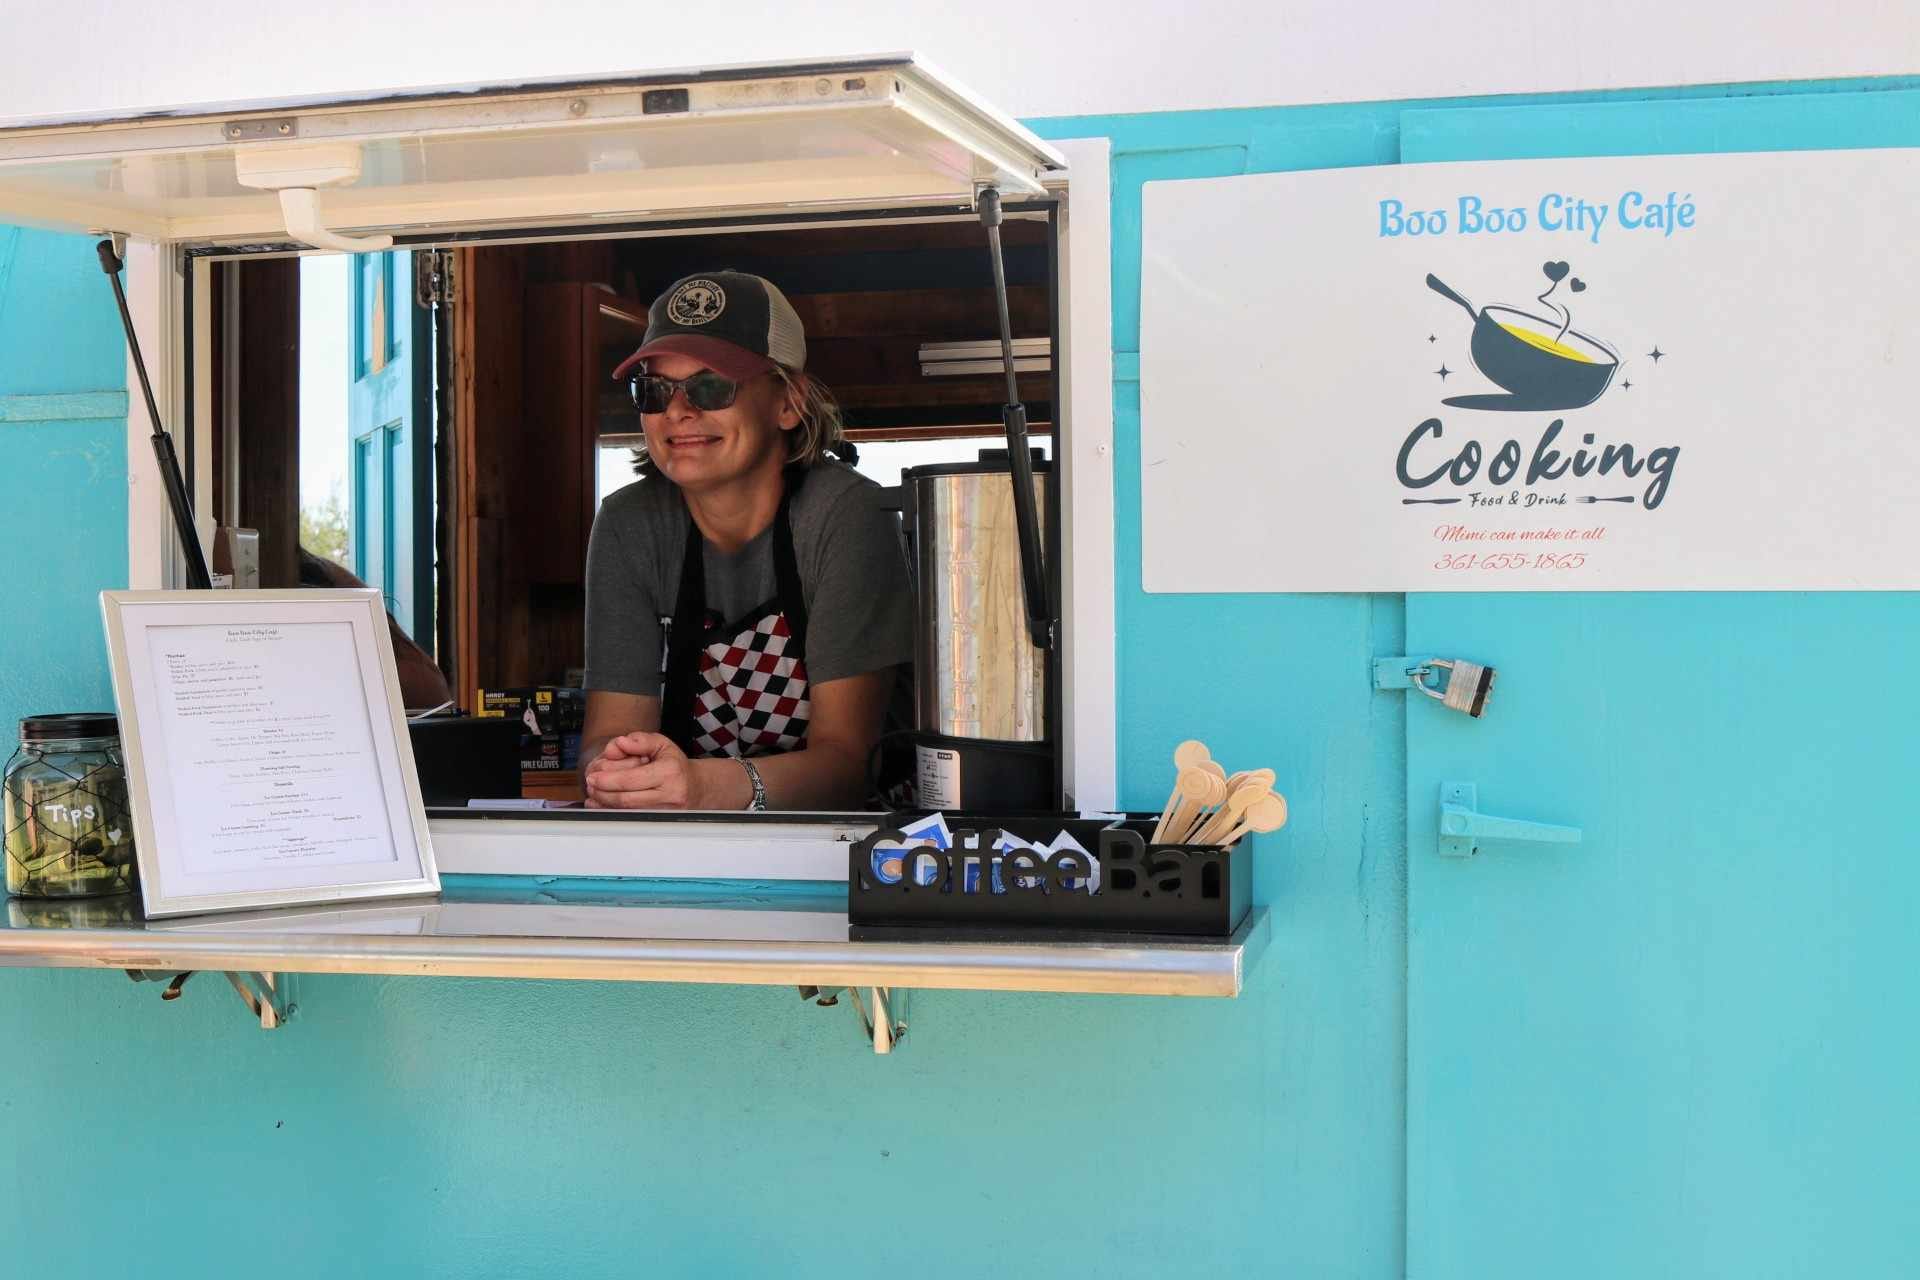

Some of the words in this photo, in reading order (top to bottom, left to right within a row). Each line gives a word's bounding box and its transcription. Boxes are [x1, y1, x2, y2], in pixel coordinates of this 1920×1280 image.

[1378, 197, 1448, 238] Boo
[1457, 195, 1527, 235] Boo
[1537, 193, 1609, 244] City
[1617, 191, 1696, 237] Café
[1396, 417, 1681, 511] Cooking
[1468, 492, 1503, 508] Food
[1507, 490, 1521, 506] &
[1524, 492, 1568, 508] Drink
[1433, 525, 1487, 542] Mimi
[1489, 530, 1516, 541] can
[1519, 527, 1562, 541] make
[1564, 528, 1578, 541] it
[1582, 527, 1606, 541] all
[1433, 552, 1588, 570] 361-655-1865
[45, 804, 95, 828] Tips
[860, 828, 1092, 896] Coffee
[1100, 828, 1223, 897] Bar
